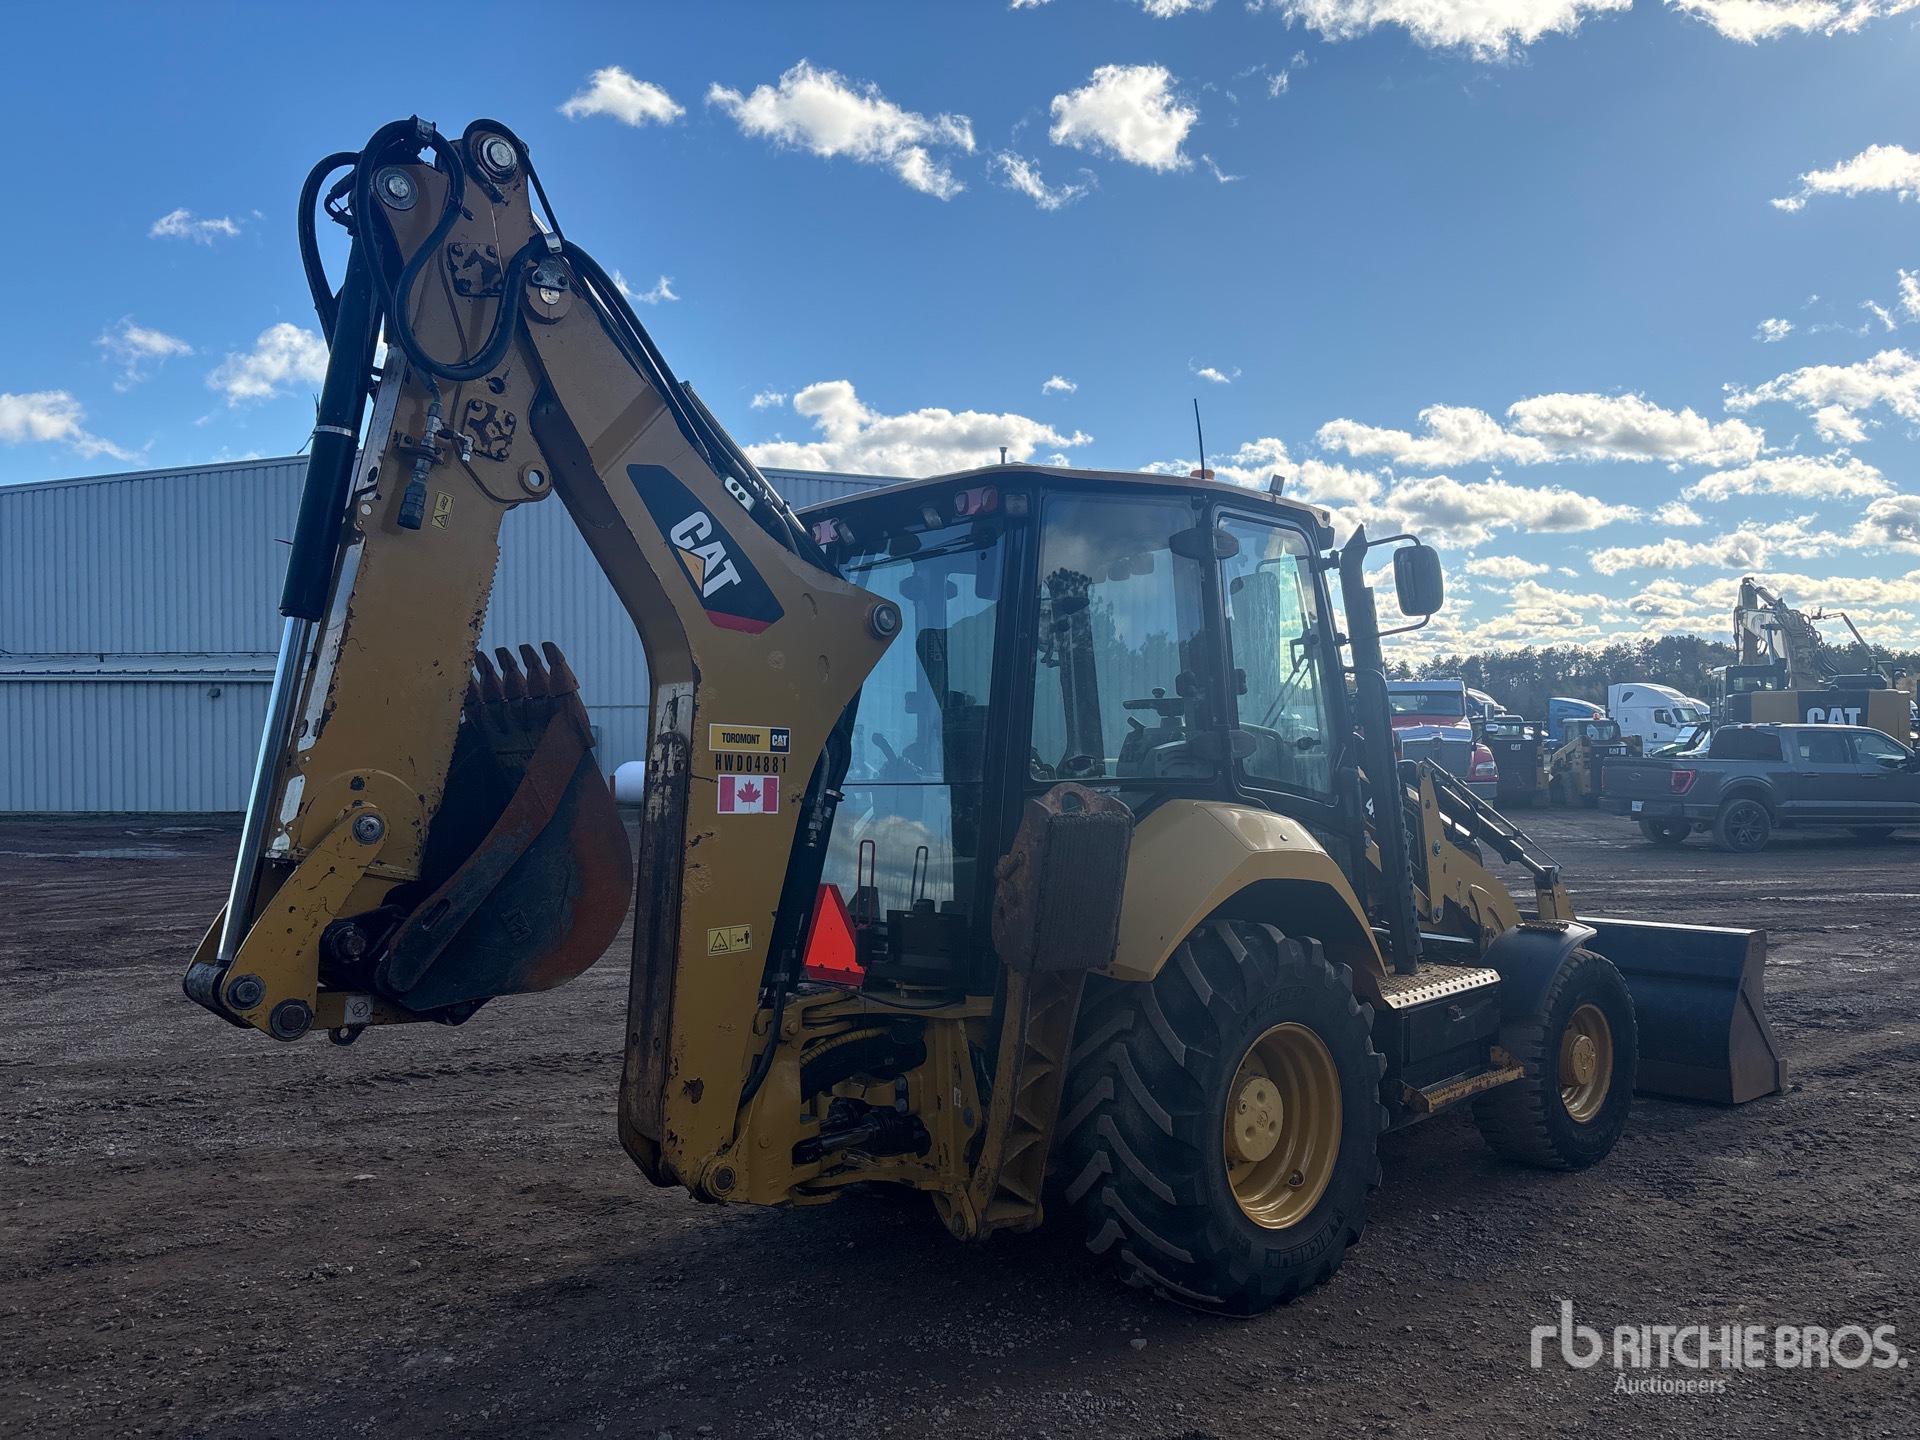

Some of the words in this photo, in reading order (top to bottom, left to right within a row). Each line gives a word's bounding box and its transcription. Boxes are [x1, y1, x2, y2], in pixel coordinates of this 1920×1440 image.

[670, 511, 742, 599] CAT
[1806, 707, 1862, 725] CAT
[721, 732, 761, 745] TOROMONT
[772, 734, 789, 747] CAT
[715, 753, 787, 773] HWD04881
[1255, 986, 1318, 1018] MICHEL
[1266, 1224, 1338, 1269] MICHELIN
